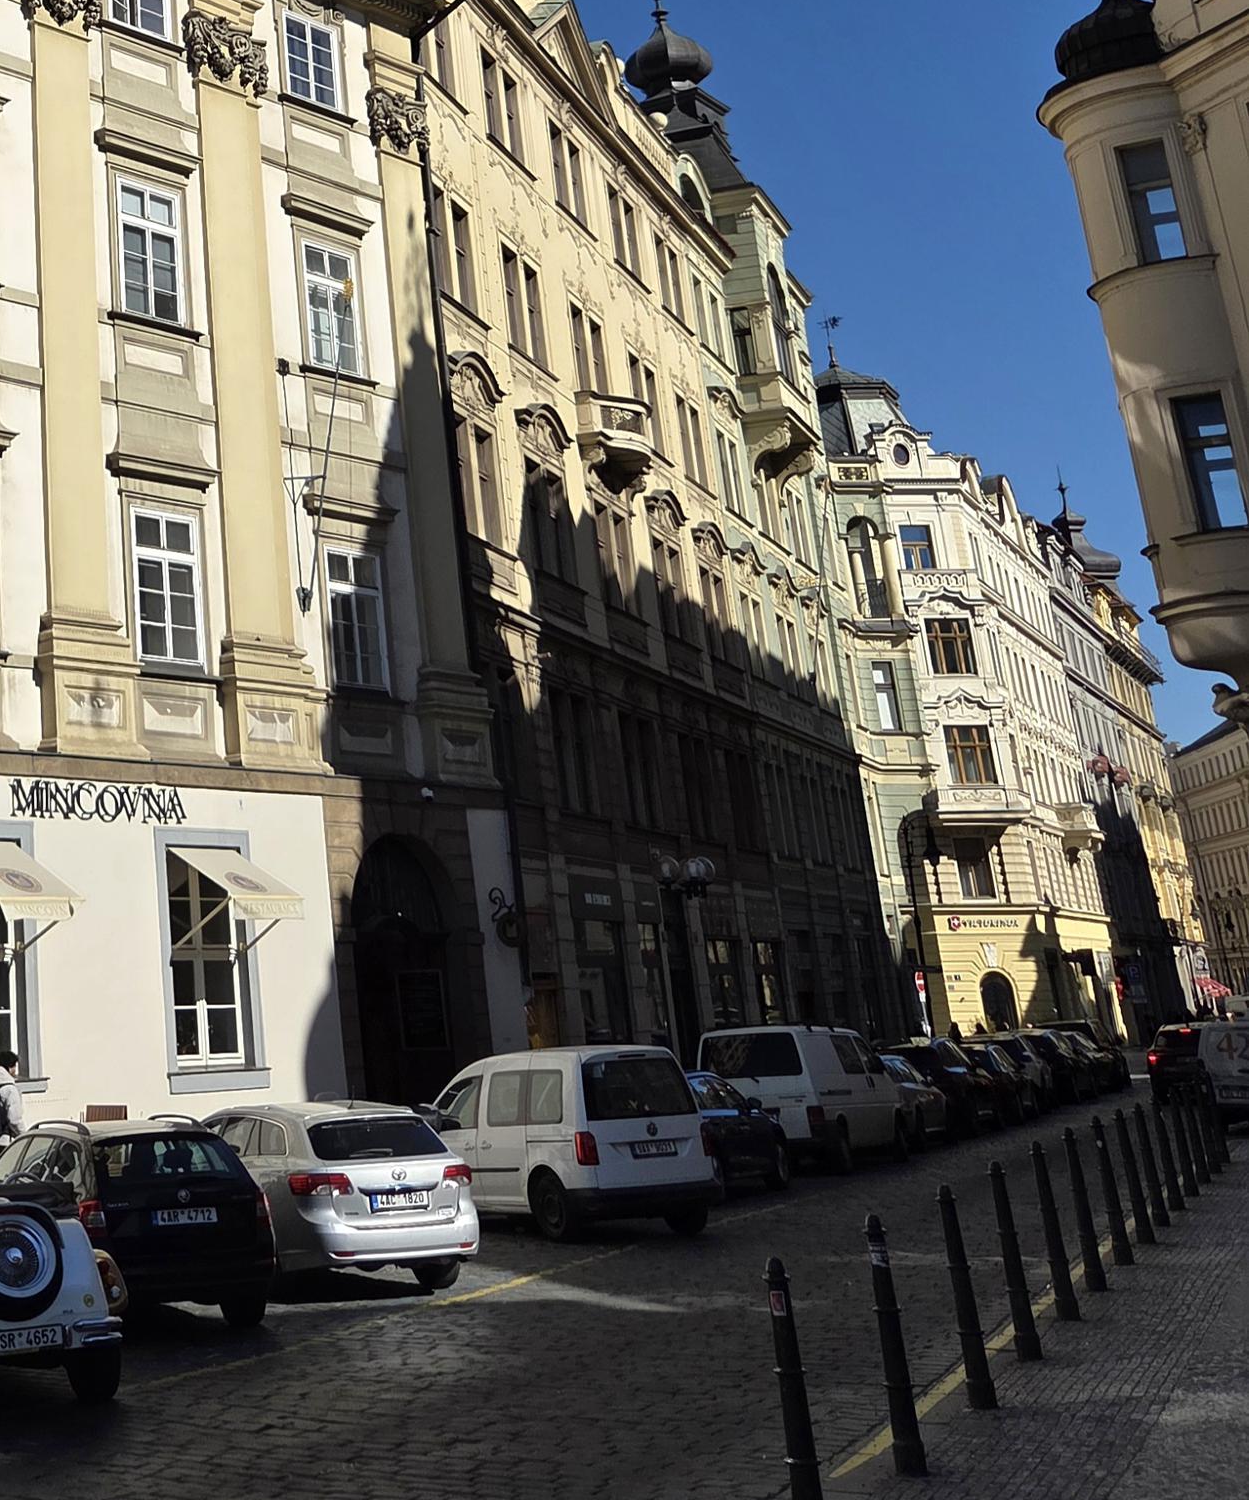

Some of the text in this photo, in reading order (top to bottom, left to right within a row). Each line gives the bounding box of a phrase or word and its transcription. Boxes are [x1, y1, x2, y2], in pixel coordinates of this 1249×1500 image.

[9, 778, 187, 825] MINCOVNA
[380, 1193, 424, 1206] 4AC 1820
[161, 1209, 212, 1223] 4AR 4712
[26, 1329, 57, 1346] 4652
